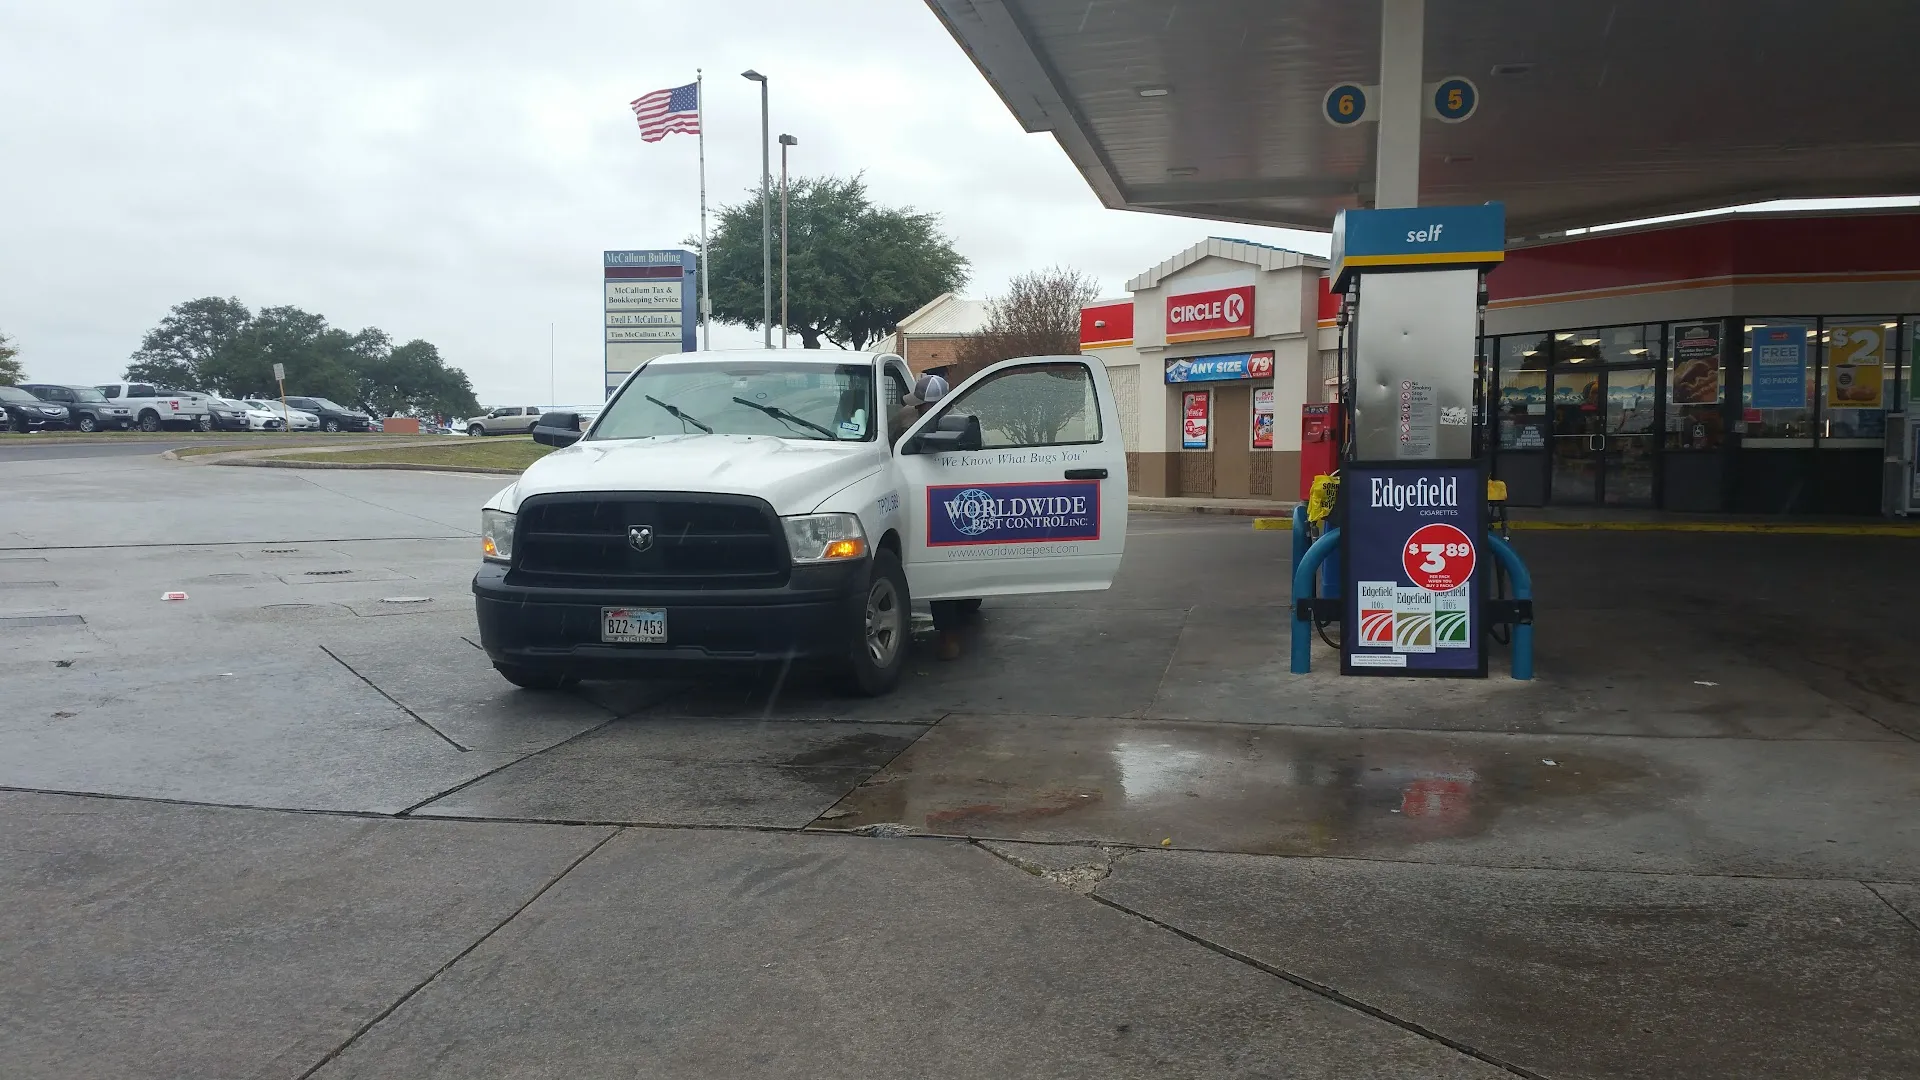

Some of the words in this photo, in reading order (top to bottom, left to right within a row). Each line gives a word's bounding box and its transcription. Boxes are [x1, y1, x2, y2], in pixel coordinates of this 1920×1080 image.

[1338, 94, 1354, 116] 6
[1447, 88, 1463, 110] 5
[1406, 224, 1443, 243] self
[606, 252, 646, 263] McCallum
[648, 252, 681, 264] Building
[614, 286, 650, 294] McCallum
[652, 286, 664, 294] Tax
[666, 286, 673, 294] &
[608, 296, 652, 305] Bookkeeping
[653, 296, 679, 304] Service
[1170, 301, 1221, 323] CIRCLE
[1226, 295, 1243, 322] K
[634, 315, 663, 324] McCallum
[1761, 347, 1797, 357] FREE
[1190, 362, 1215, 375] ANY
[1216, 360, 1242, 373] SIZE
[960, 456, 994, 467] Know
[997, 453, 1027, 465] What
[1030, 453, 1057, 465] Bugs
[1322, 482, 1340, 490] SORR
[1370, 476, 1458, 512] Edgefield
[944, 496, 1087, 520] WORLDWIDE
[972, 518, 1004, 531] PEST
[1005, 515, 1069, 530] CONTROL
[947, 544, 1080, 559] www.worldwidepest.com
[1361, 586, 1393, 599] Edgefield
[1396, 592, 1432, 606] Edgefield
[608, 619, 628, 634] BZ2
[636, 619, 663, 635] 7453
